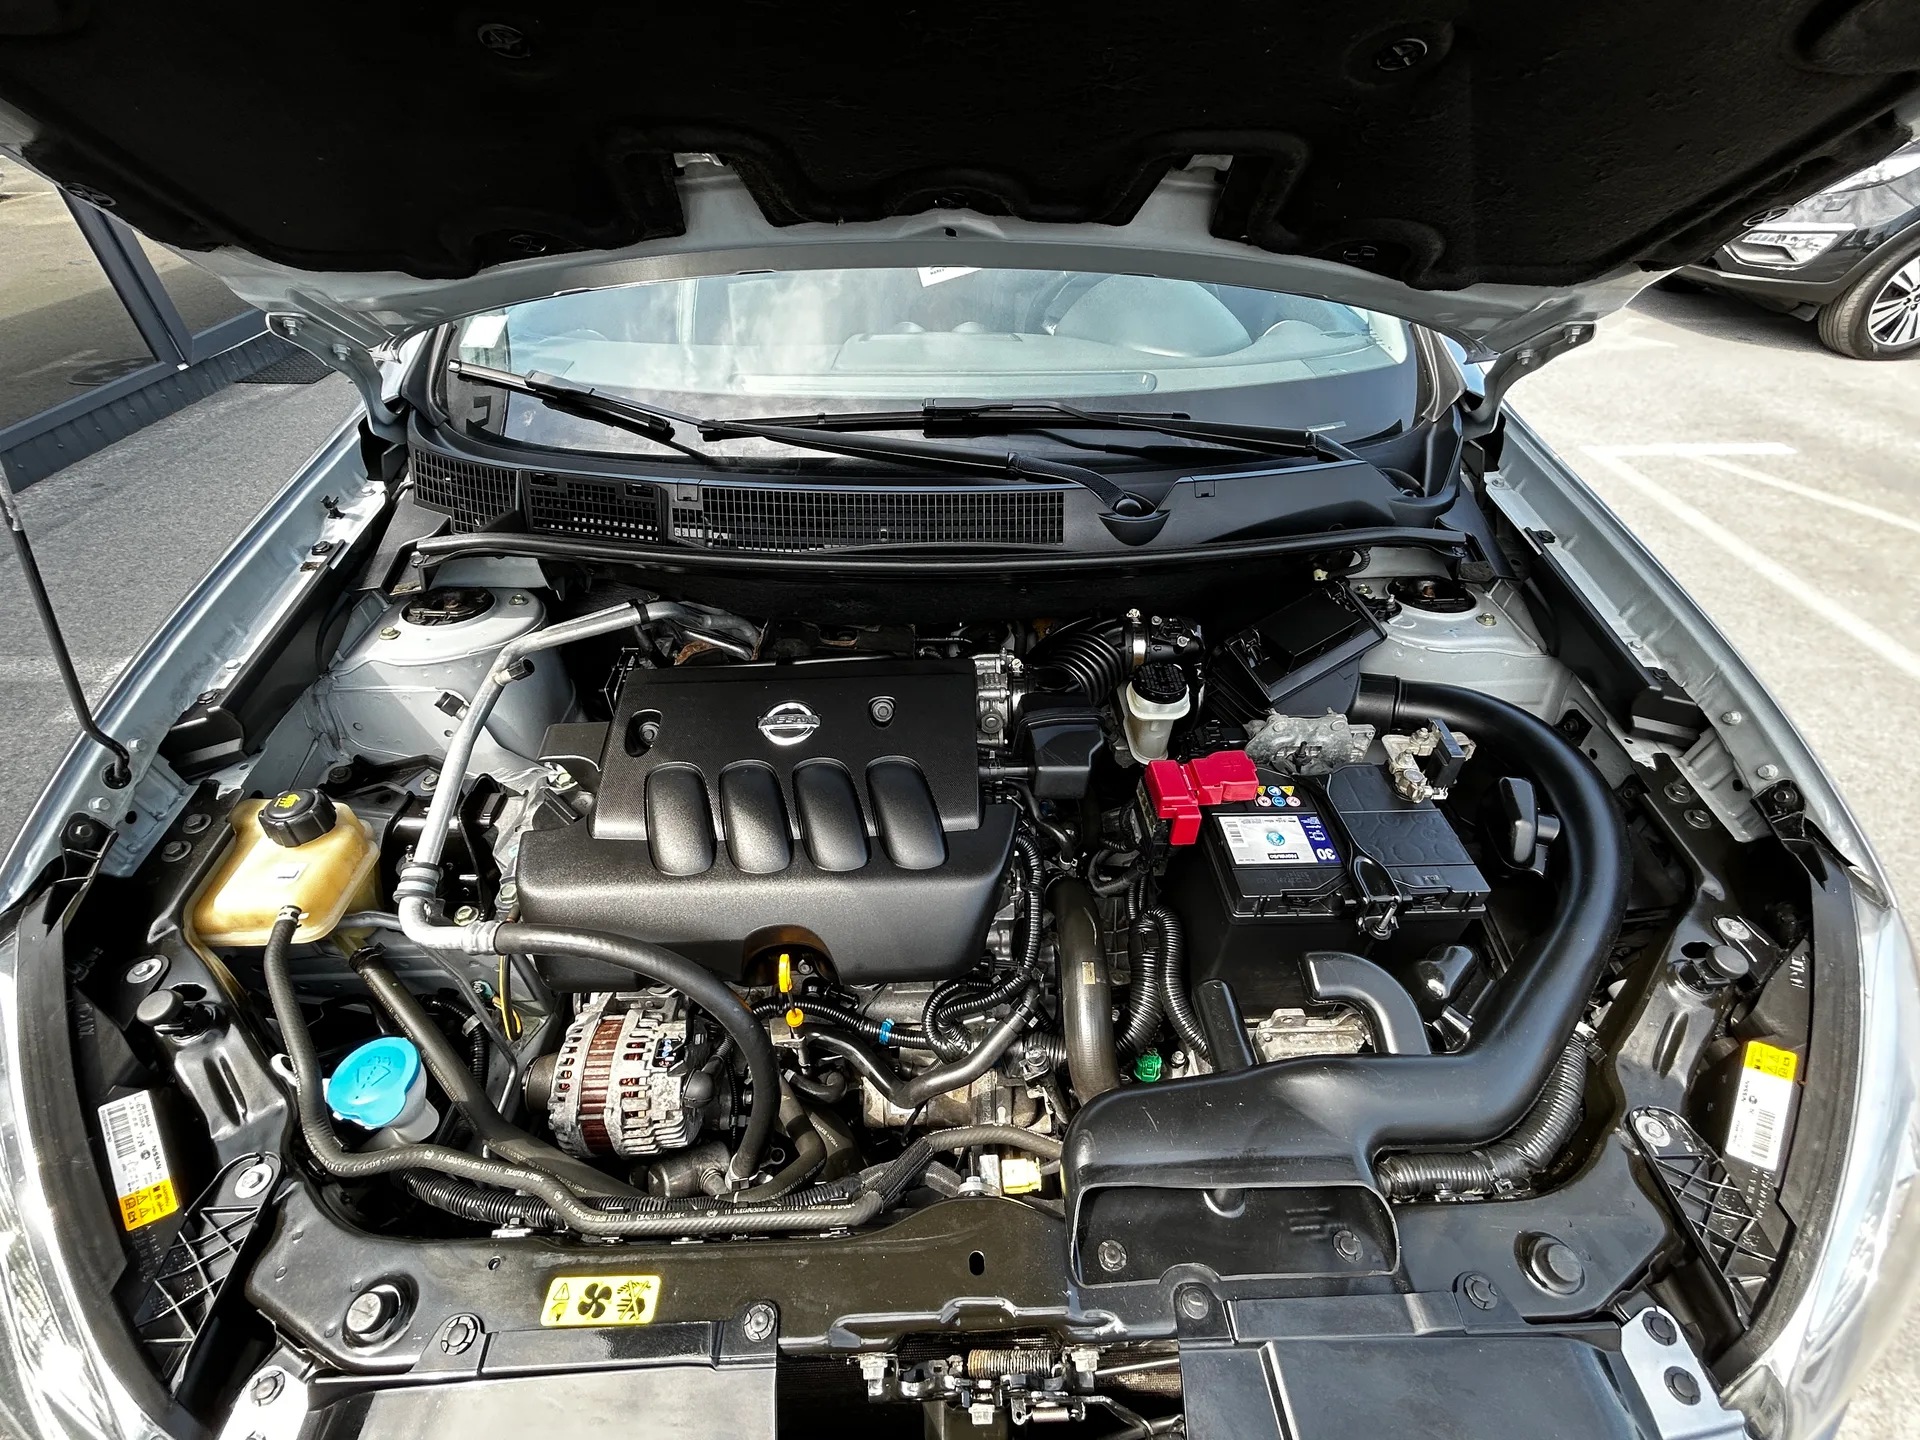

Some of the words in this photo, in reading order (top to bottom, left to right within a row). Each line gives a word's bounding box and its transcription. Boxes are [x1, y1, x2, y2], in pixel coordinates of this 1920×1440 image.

[761, 715, 815, 725] NISSAN
[1316, 847, 1336, 862] 30
[152, 1144, 163, 1171] NISSAN
